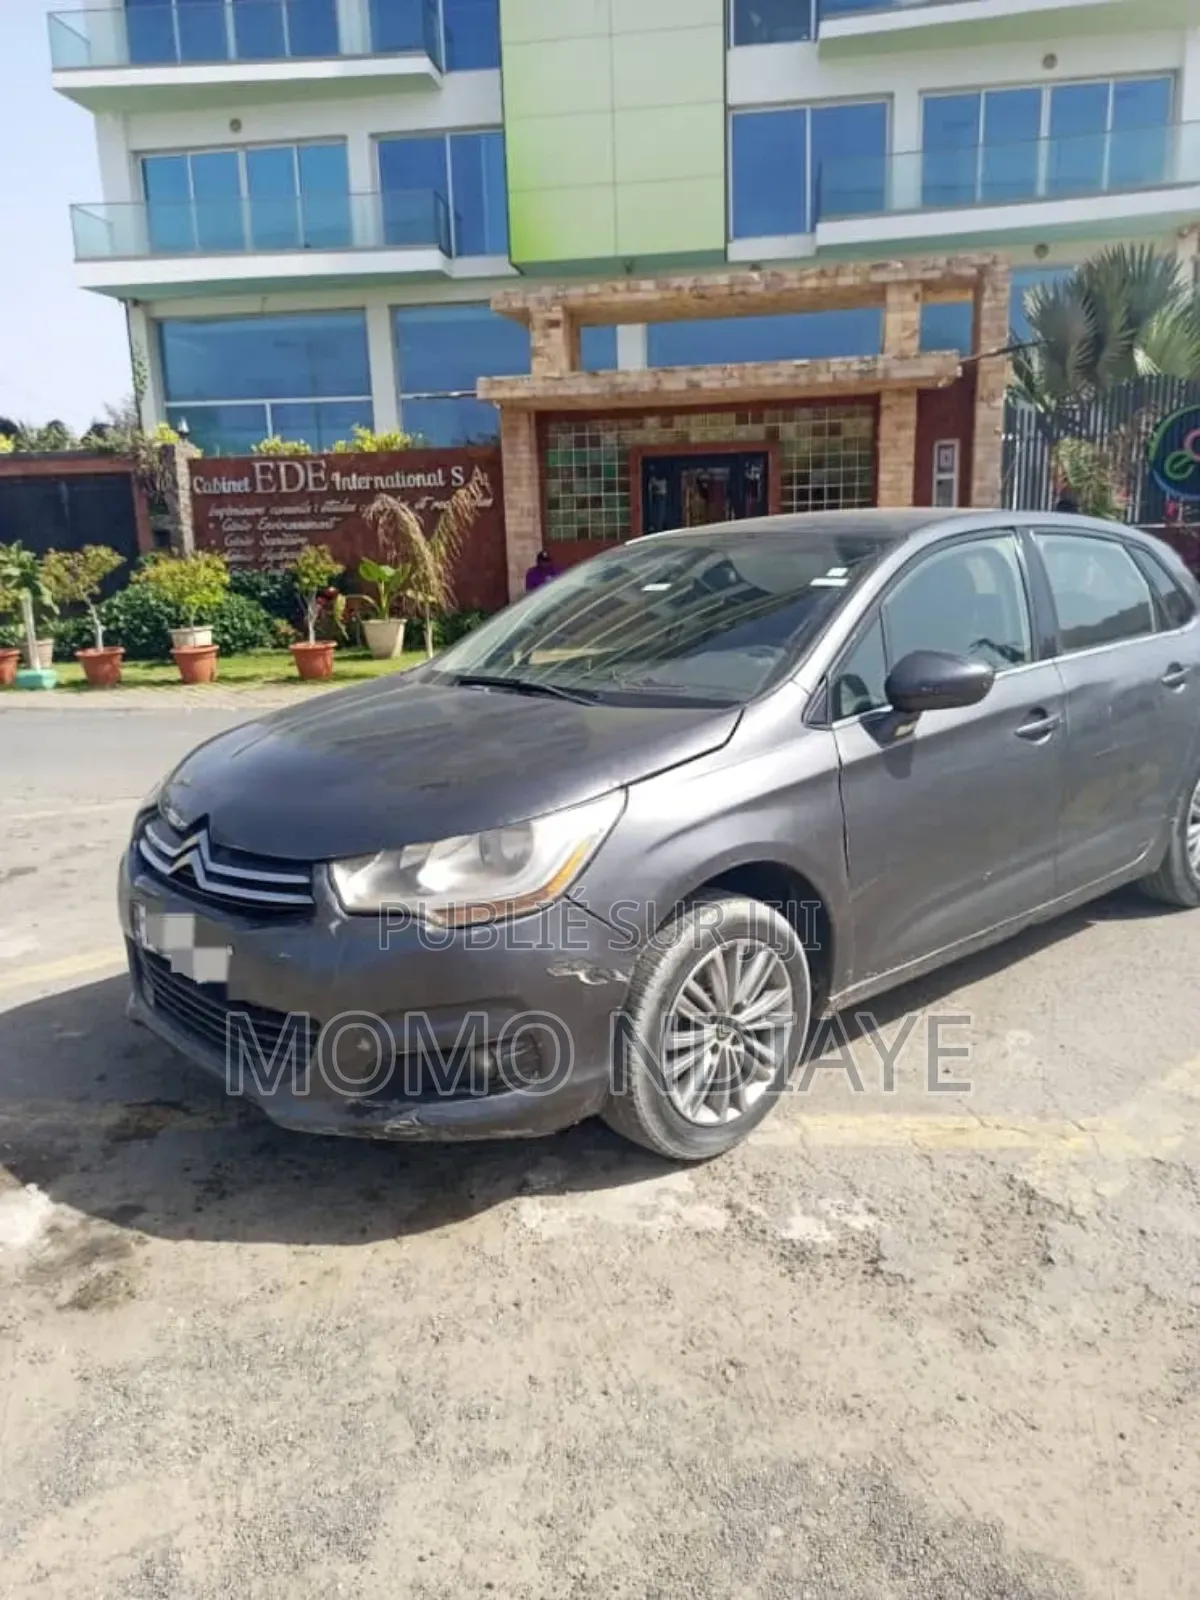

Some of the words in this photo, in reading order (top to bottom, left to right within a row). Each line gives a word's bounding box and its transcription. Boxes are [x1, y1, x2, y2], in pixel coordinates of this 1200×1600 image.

[193, 475, 251, 494] Cabinet
[254, 459, 328, 493] EDE
[331, 468, 446, 491] International
[451, 466, 465, 487] S
